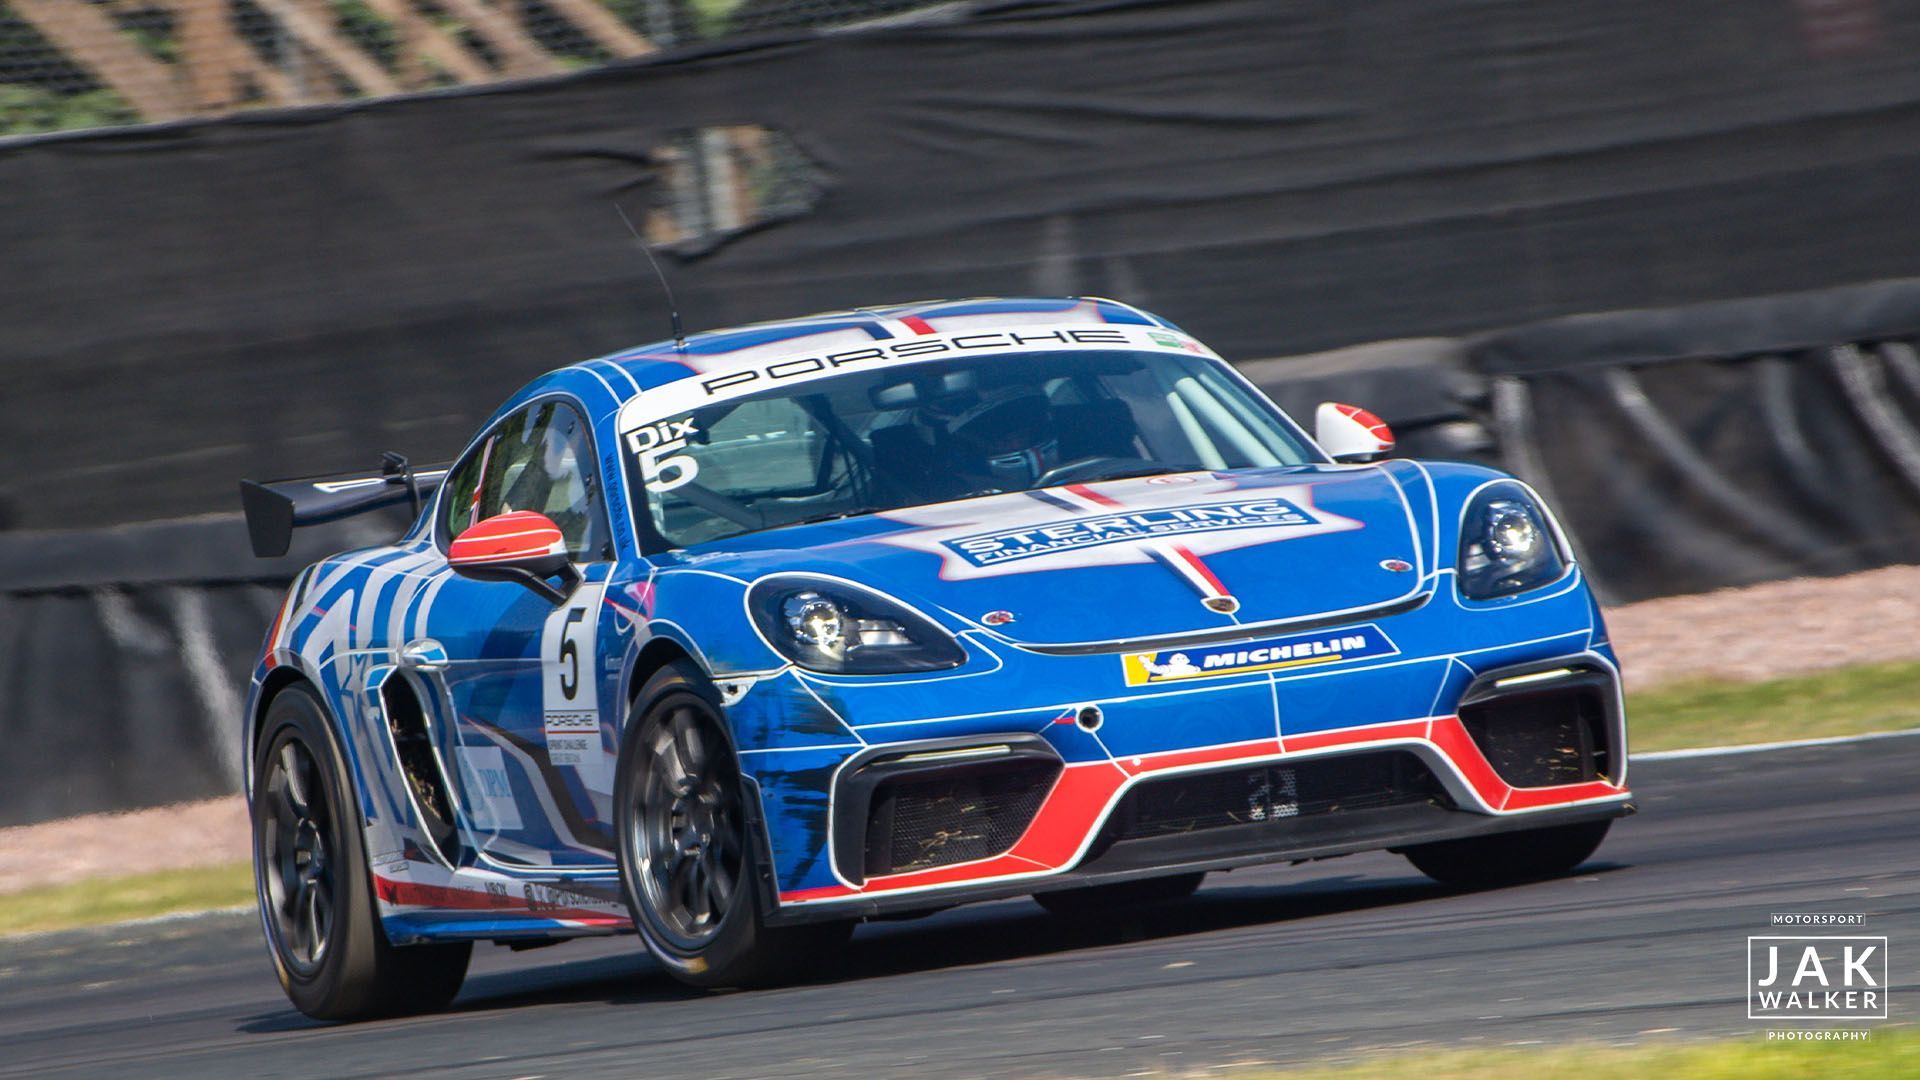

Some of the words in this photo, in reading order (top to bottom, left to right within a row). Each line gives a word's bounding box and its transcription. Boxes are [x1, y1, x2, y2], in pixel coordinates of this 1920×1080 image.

[702, 330, 1131, 395] PORSCHE
[626, 417, 699, 454] Dix
[639, 438, 699, 493] 5
[960, 503, 1291, 554] STERLING
[975, 527, 1146, 562] FINANCIAL
[1149, 514, 1304, 533] SERVICES
[559, 607, 588, 700] 5
[1203, 635, 1366, 668] MICHELIN
[545, 714, 593, 726] PORSCHE
